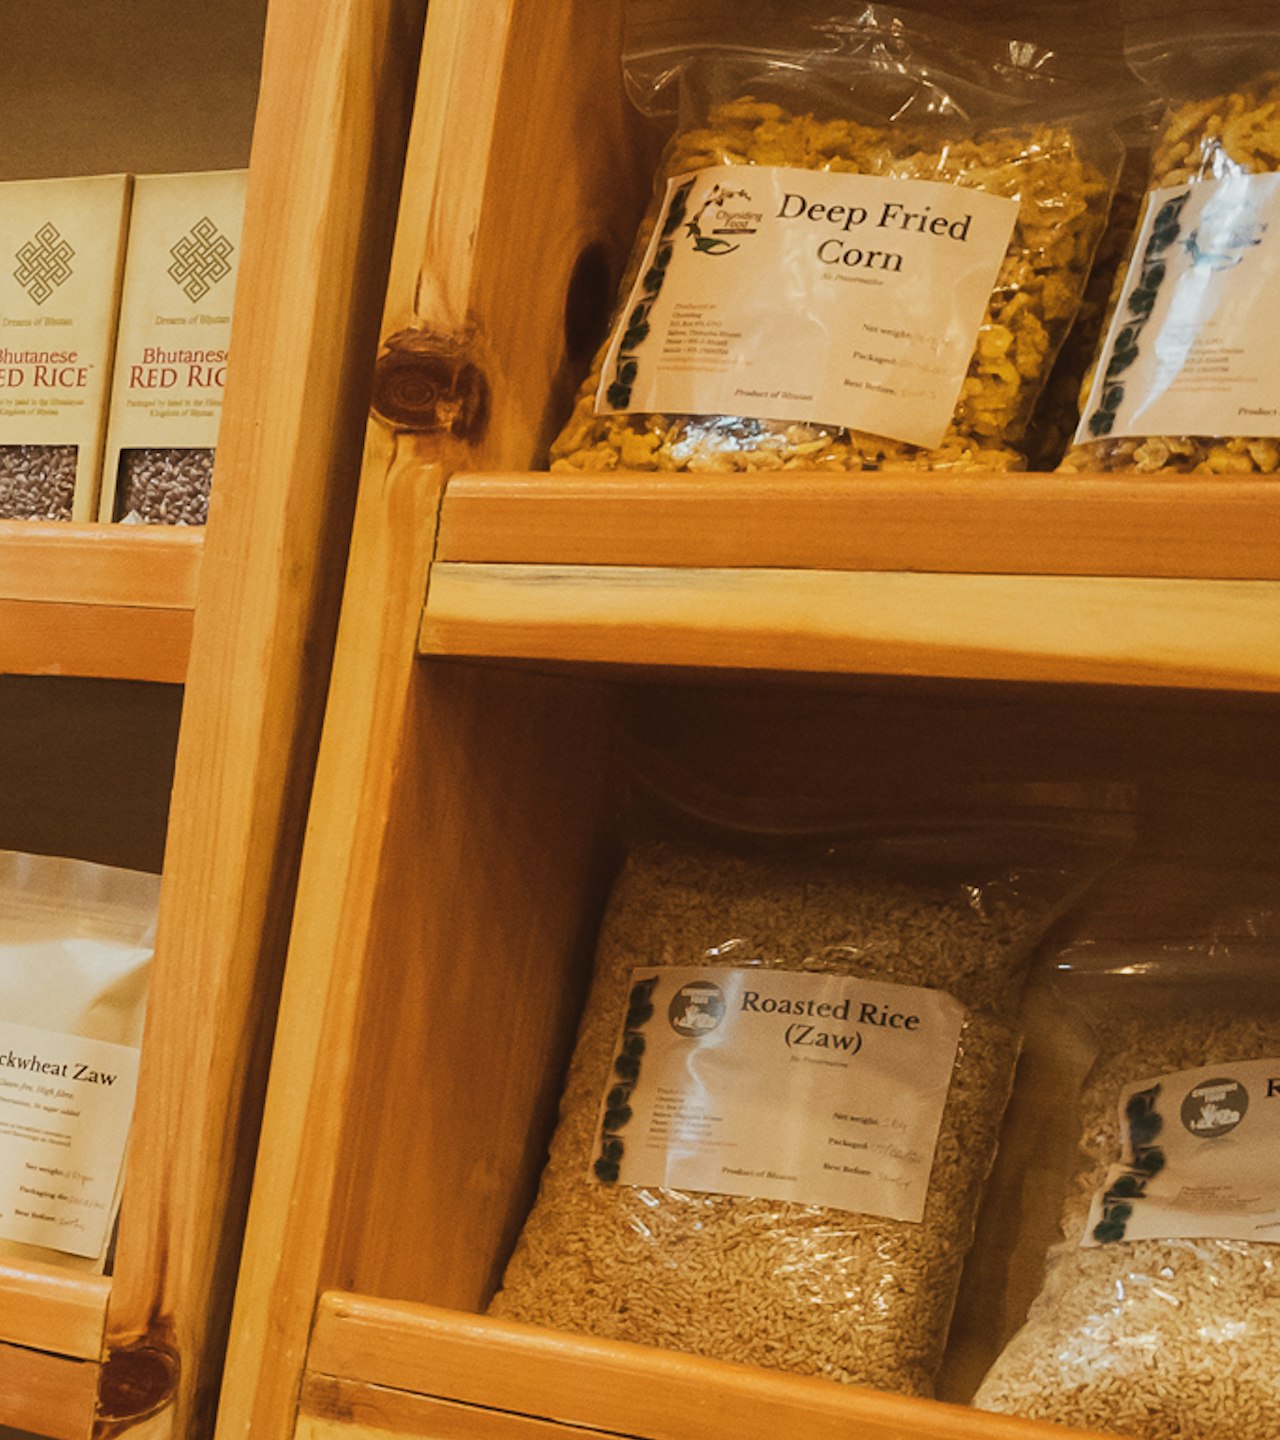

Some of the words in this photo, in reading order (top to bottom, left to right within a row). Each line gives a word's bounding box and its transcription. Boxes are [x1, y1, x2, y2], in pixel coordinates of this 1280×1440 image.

[776, 194, 867, 231] Deep
[877, 202, 972, 242] Fried
[817, 239, 903, 272] Corn
[32, 365, 88, 388] RICE
[129, 365, 177, 388] RED
[741, 991, 851, 1021] Roasted
[859, 1004, 921, 1031] Rice
[785, 1023, 863, 1056] (Zaw)
[72, 1062, 118, 1087] Zaw
